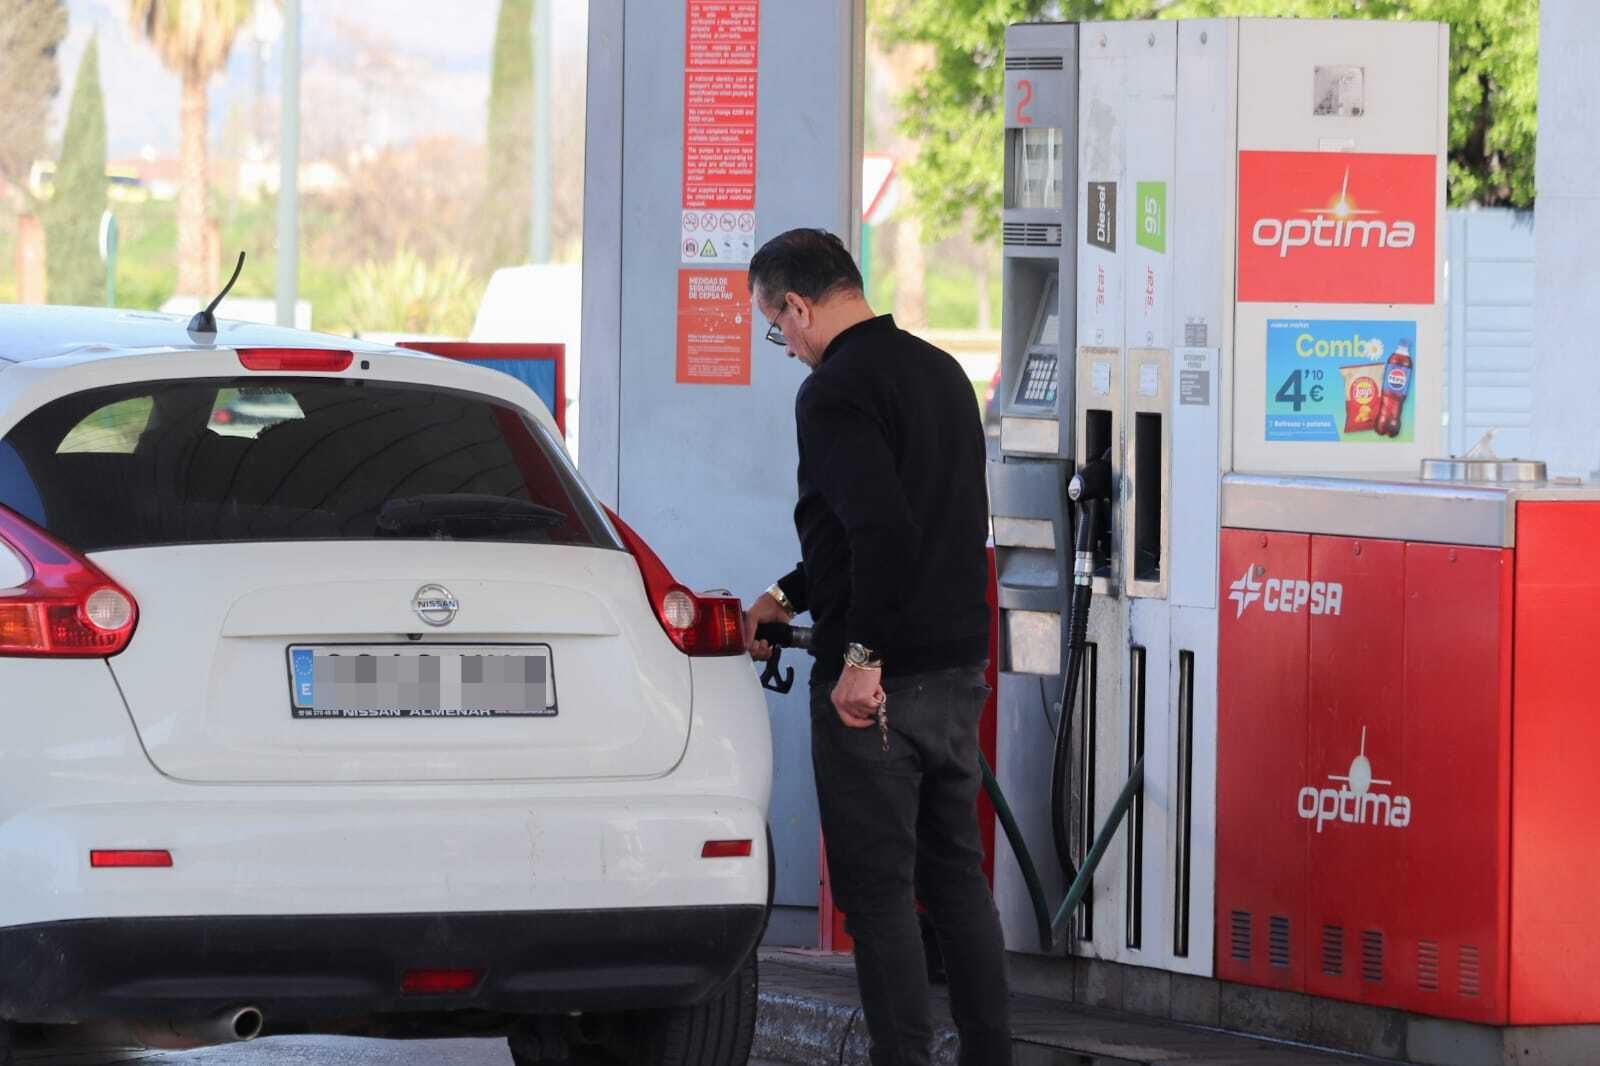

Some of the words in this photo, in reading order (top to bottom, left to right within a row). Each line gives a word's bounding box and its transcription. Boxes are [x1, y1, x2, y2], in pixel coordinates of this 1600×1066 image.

[1015, 79, 1034, 125] 2
[1097, 185, 1106, 242] Diesel
[1145, 195, 1158, 234] 95
[1252, 214, 1416, 258] optima
[1097, 264, 1105, 305] star
[1146, 263, 1154, 305] star
[417, 600, 457, 608] NISSAN
[1263, 579, 1343, 616] CEPSA
[302, 684, 313, 696] E
[343, 708, 401, 717] NISSAN
[1297, 784, 1412, 833] optima
